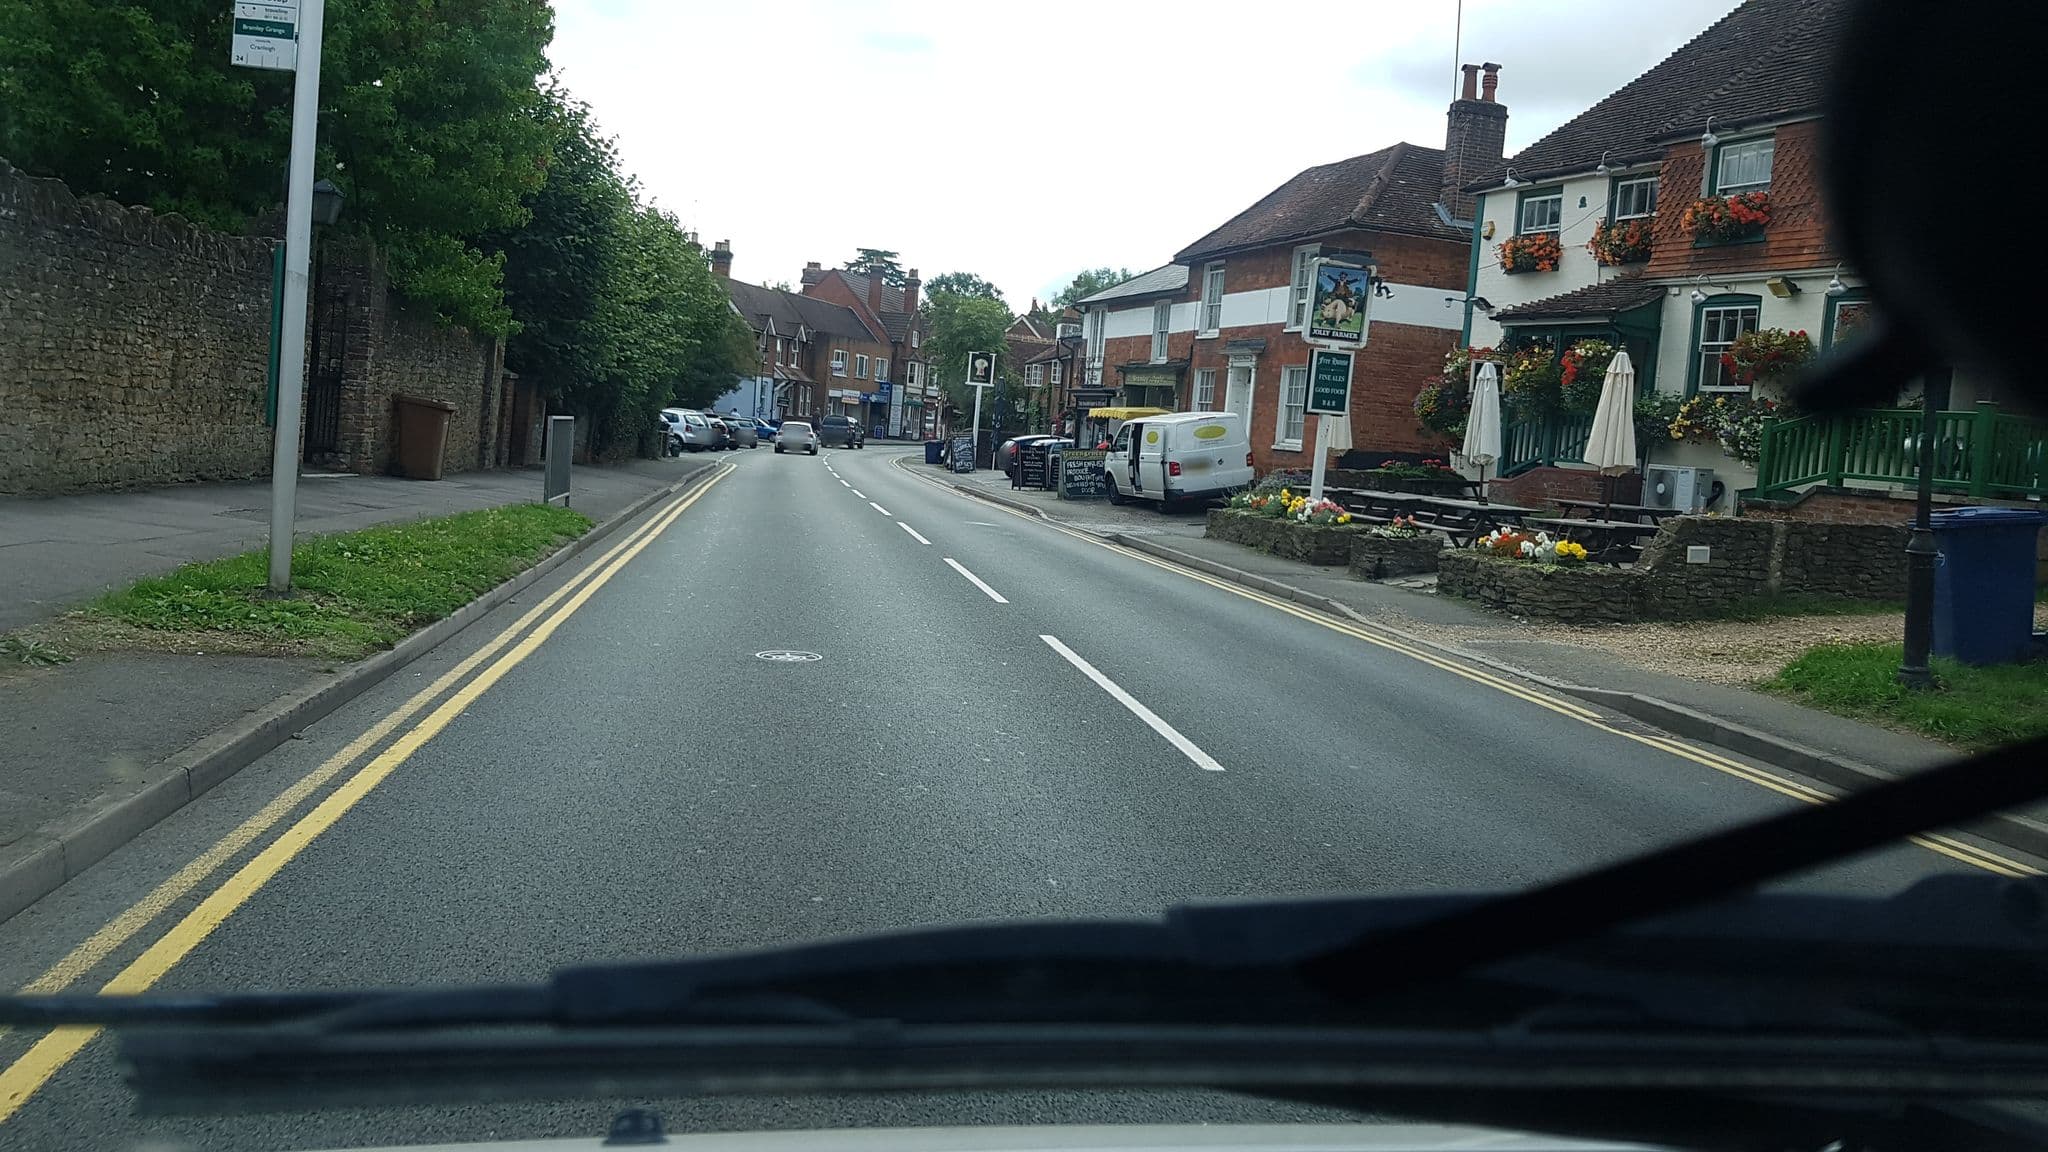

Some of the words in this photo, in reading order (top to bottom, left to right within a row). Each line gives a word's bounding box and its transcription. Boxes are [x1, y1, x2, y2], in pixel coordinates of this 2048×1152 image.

[1332, 331, 1358, 339] FARMER
[1314, 386, 1331, 394] GOOD
[1331, 388, 1345, 396] FOOD
